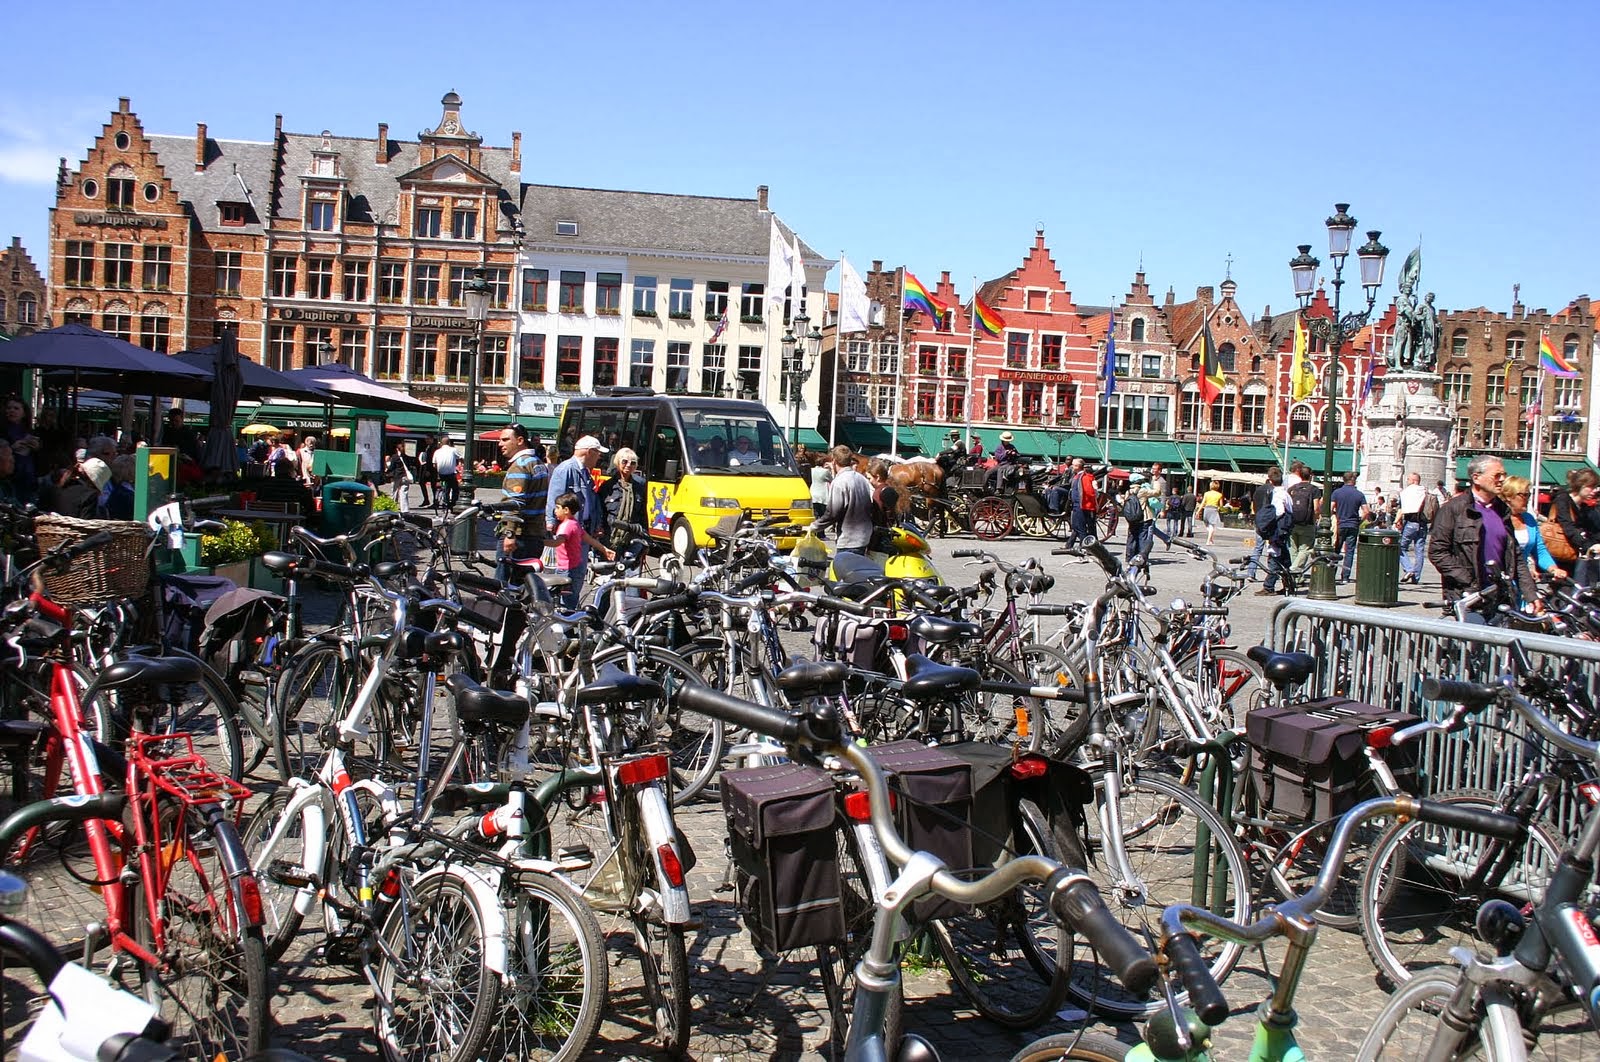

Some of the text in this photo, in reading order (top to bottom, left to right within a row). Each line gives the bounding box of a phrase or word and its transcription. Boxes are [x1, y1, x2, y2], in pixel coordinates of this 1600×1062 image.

[98, 214, 141, 226] Jupiler
[298, 309, 339, 321] Jupiler
[421, 316, 461, 328] Jupiler
[1015, 372, 1046, 380] PANIER
